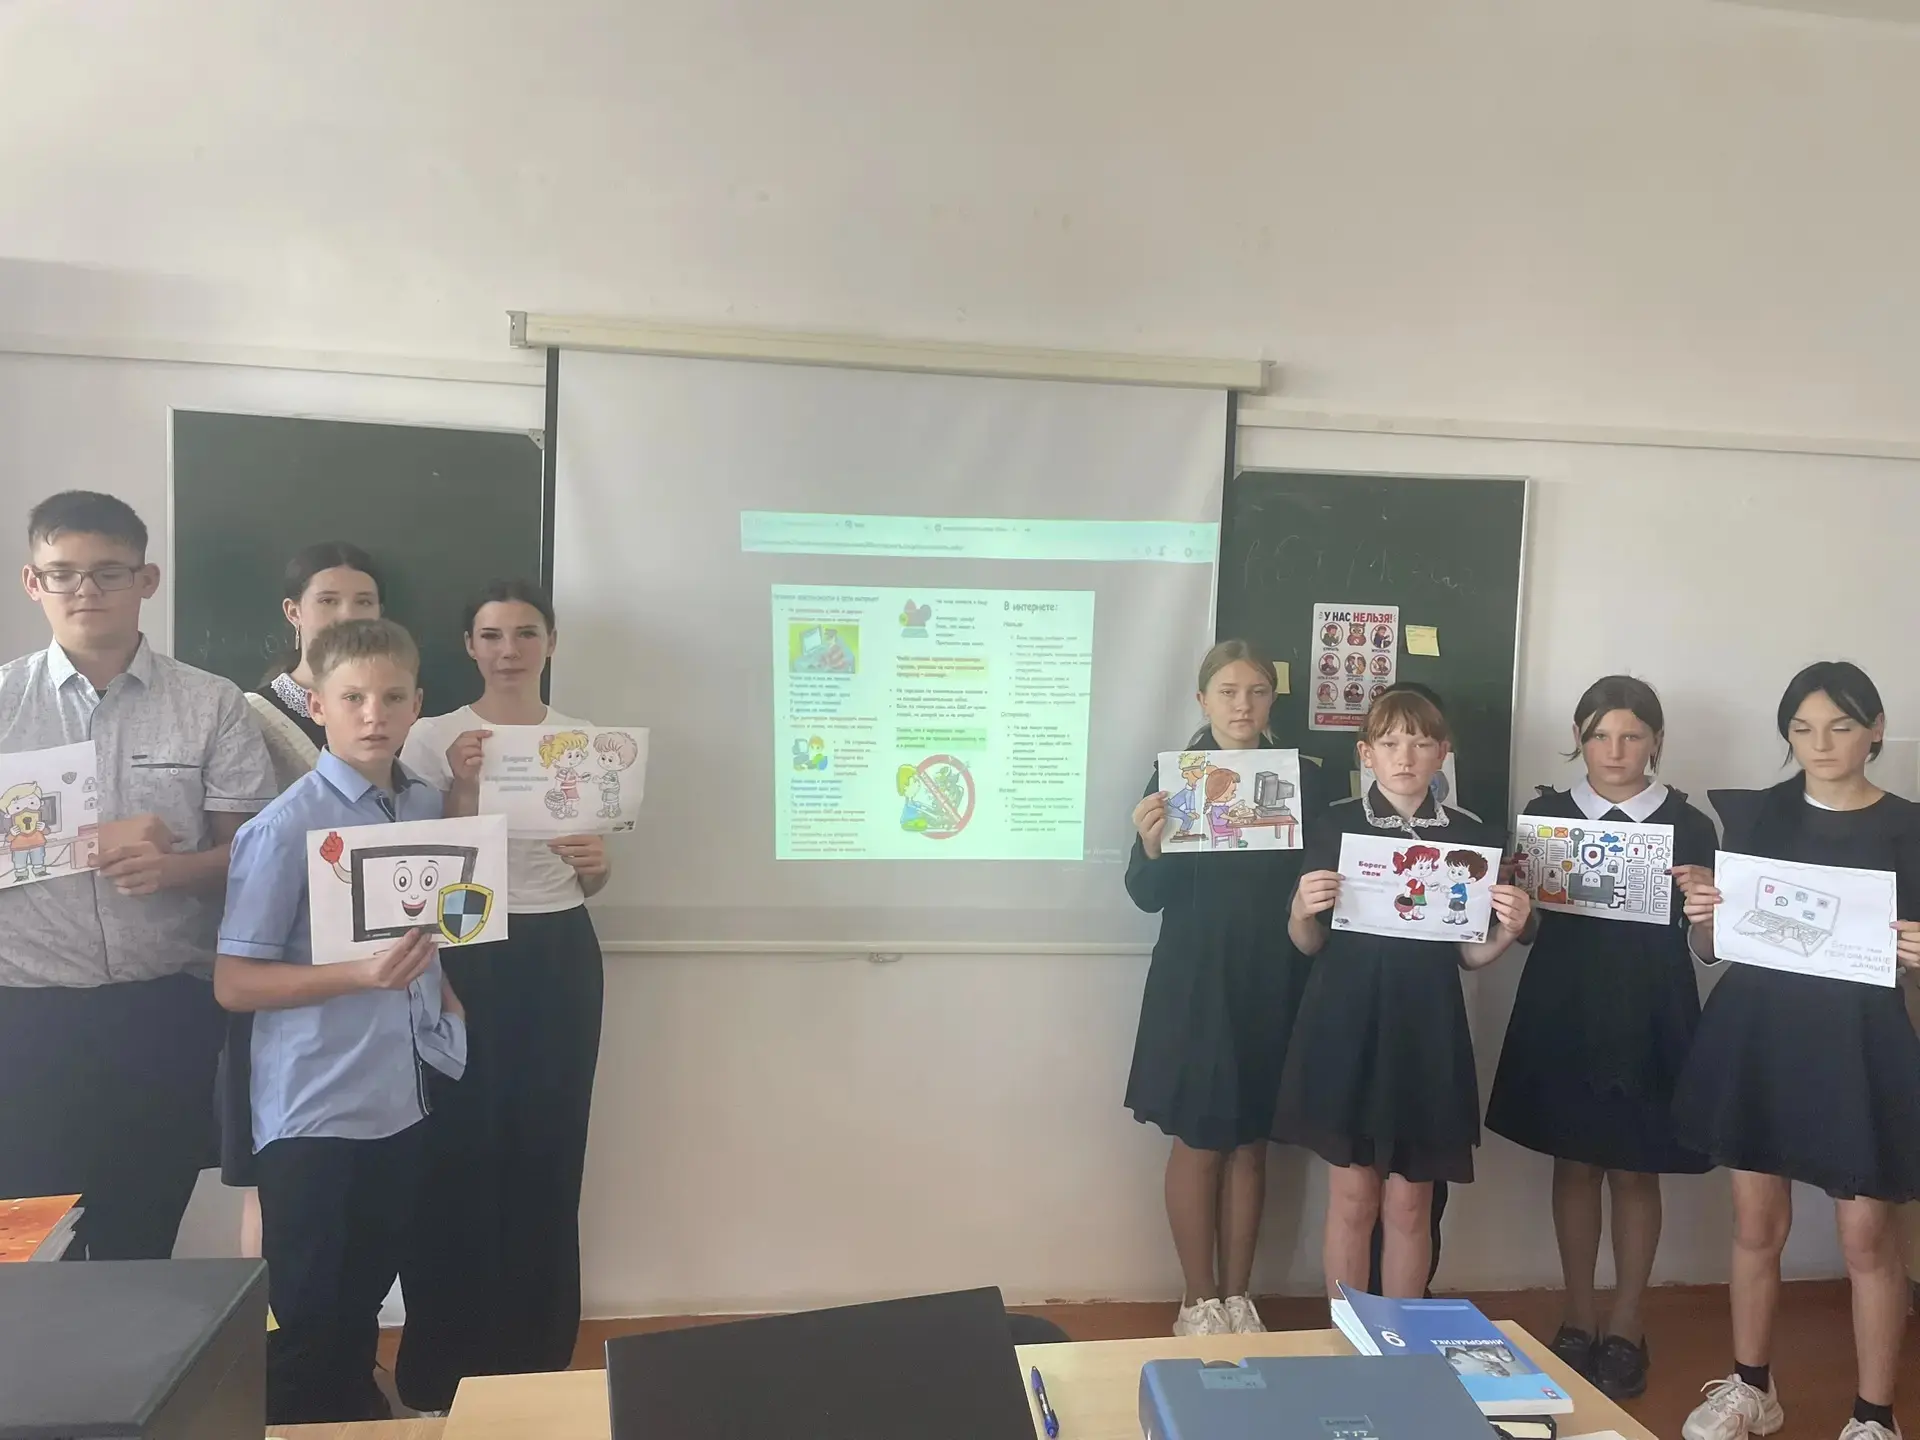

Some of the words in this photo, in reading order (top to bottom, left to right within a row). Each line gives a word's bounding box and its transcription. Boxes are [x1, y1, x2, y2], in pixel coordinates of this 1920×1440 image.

[1003, 601, 1010, 611] В
[1012, 603, 1059, 614] интернете:
[1324, 611, 1331, 622] У
[1332, 611, 1351, 622] НАС
[1353, 612, 1393, 624] НЕЛЬЗЯ!
[1430, 1338, 1505, 1346] ИНФОРМАТИКА
